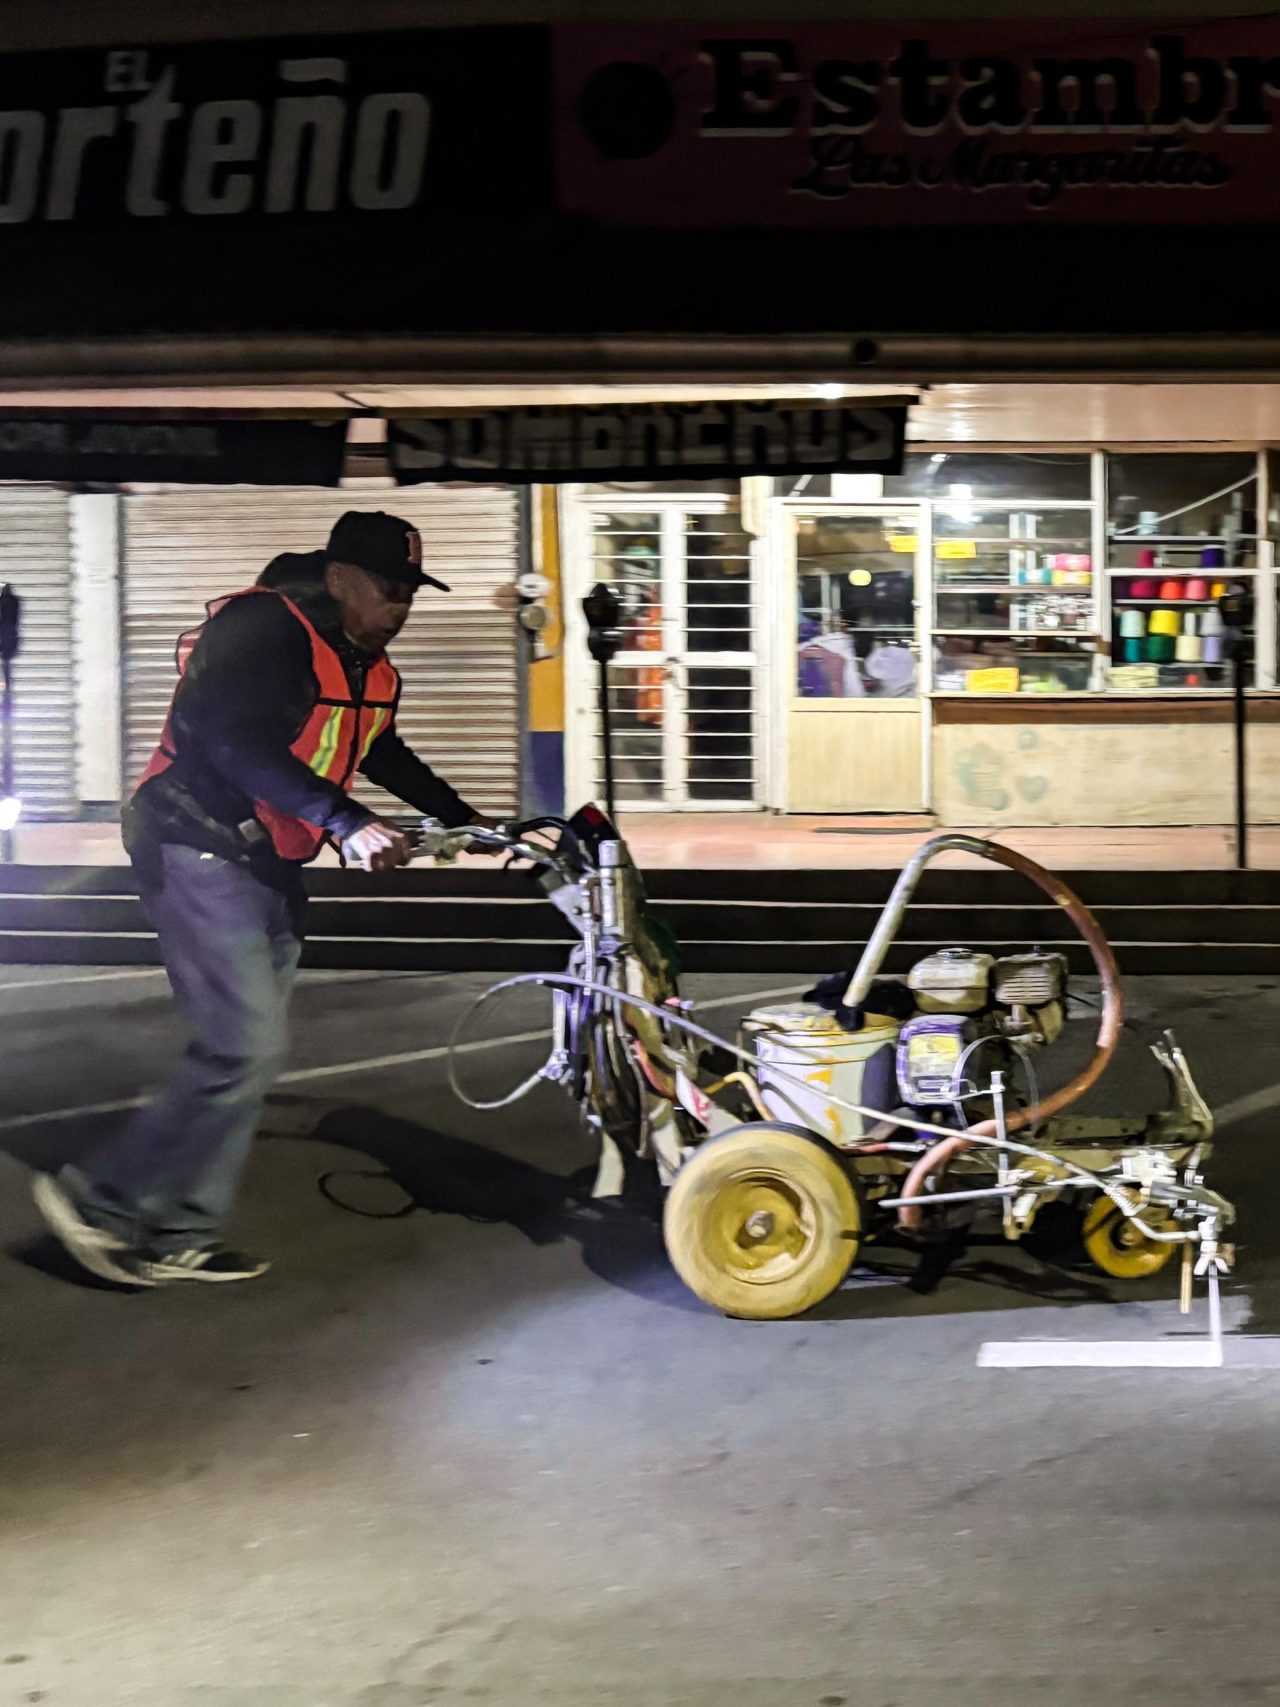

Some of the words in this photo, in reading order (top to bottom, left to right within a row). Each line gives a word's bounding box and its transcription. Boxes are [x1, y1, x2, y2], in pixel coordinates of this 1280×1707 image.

[104, 49, 154, 93] EL
[787, 133, 912, 198] Las
[918, 135, 1232, 209] Margaritas
